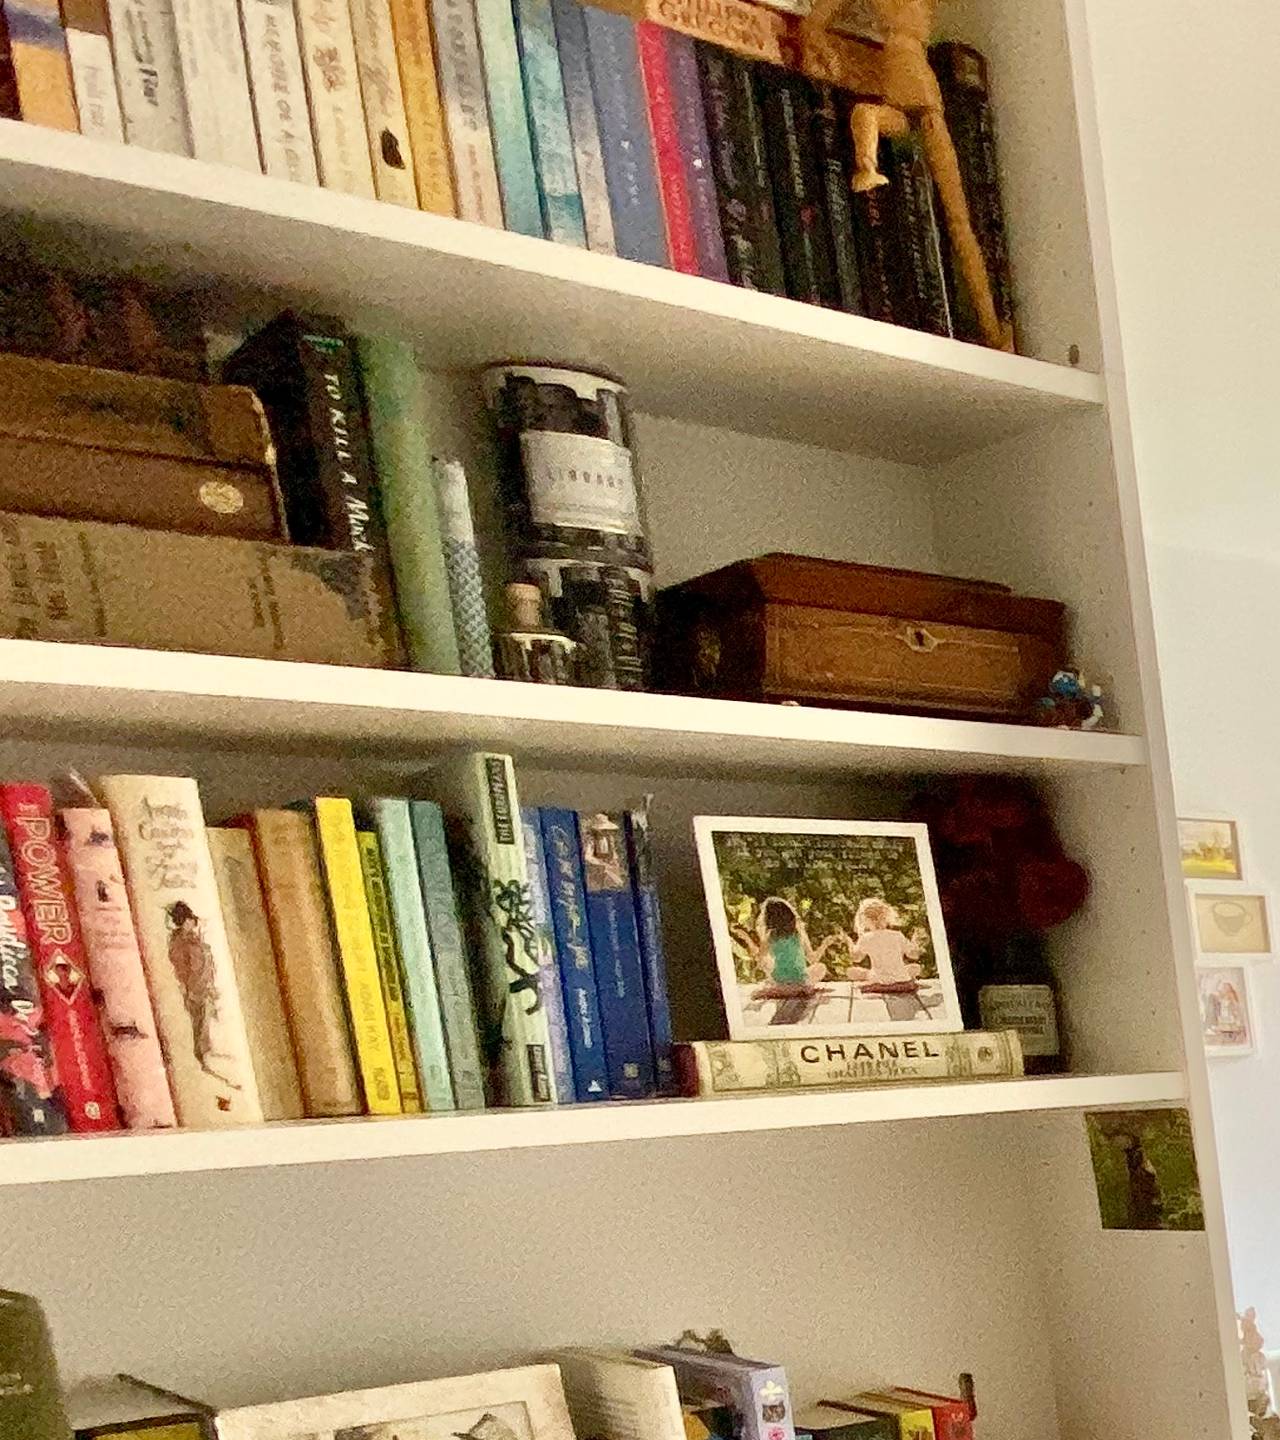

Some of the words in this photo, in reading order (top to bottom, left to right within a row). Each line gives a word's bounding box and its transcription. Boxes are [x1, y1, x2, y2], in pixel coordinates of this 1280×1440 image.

[325, 374, 341, 400] TO
[330, 408, 350, 460] KILL
[341, 471, 357, 484] A
[17, 816, 72, 945] POWER
[800, 1041, 939, 1063] CHANEL
